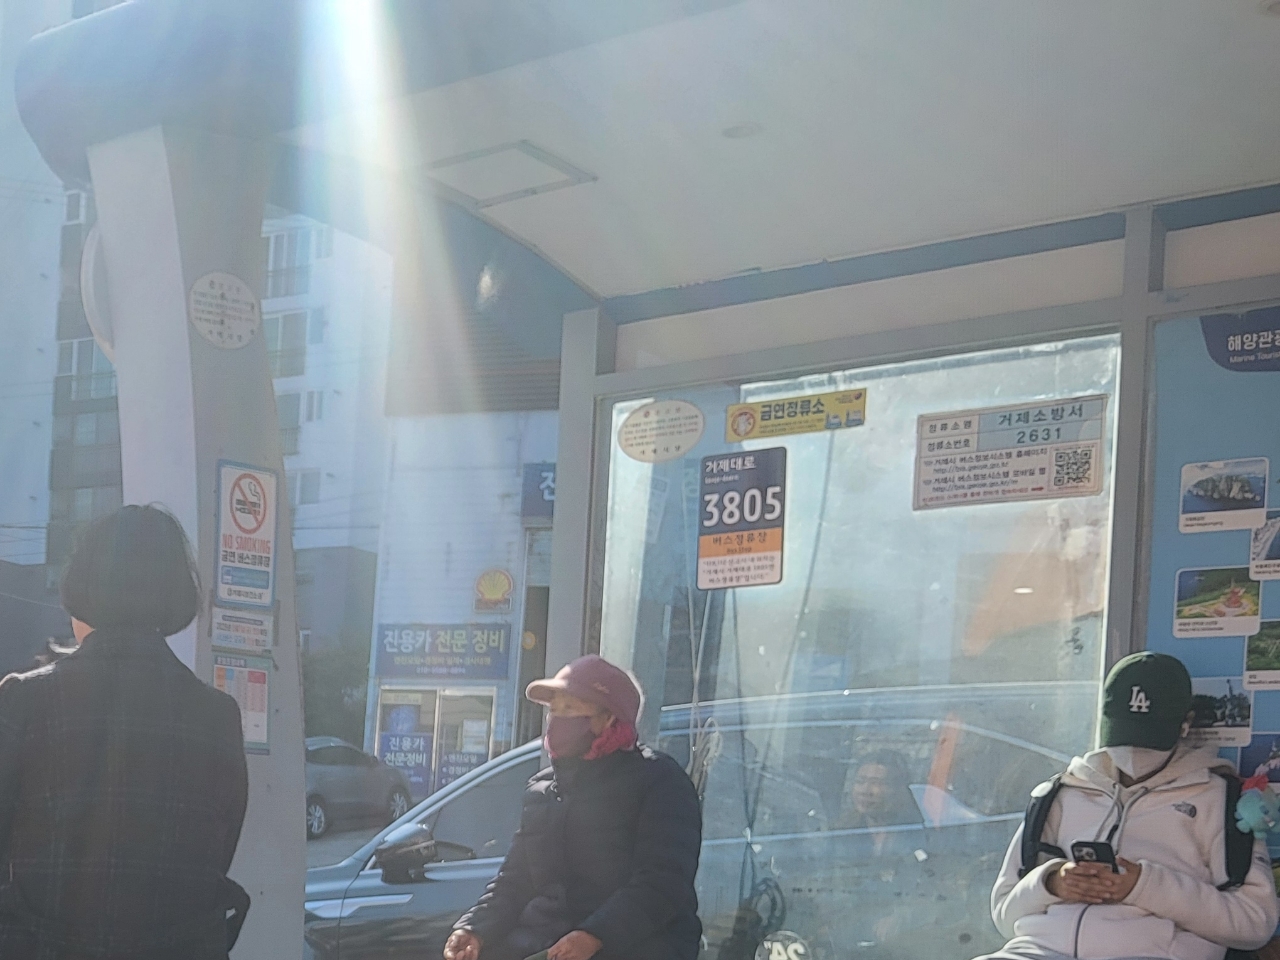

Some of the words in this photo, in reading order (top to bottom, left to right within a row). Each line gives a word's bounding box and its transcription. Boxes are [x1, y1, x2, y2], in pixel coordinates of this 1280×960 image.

[1229, 354, 1255, 364] Marine
[760, 396, 825, 421] 금연정류소
[998, 404, 1084, 426] 거제소방서
[1016, 428, 1062, 444] 2631
[705, 455, 756, 473] 거제대로
[703, 486, 782, 527] 3805
[222, 534, 233, 549] NO
[236, 535, 271, 555] SMOKING
[712, 531, 767, 546] 버스정류장
[384, 629, 431, 653] 진용카
[435, 629, 467, 653] 전문
[472, 629, 504, 653] 정비
[1129, 686, 1150, 712] LA
[384, 752, 426, 767] 전문정비
